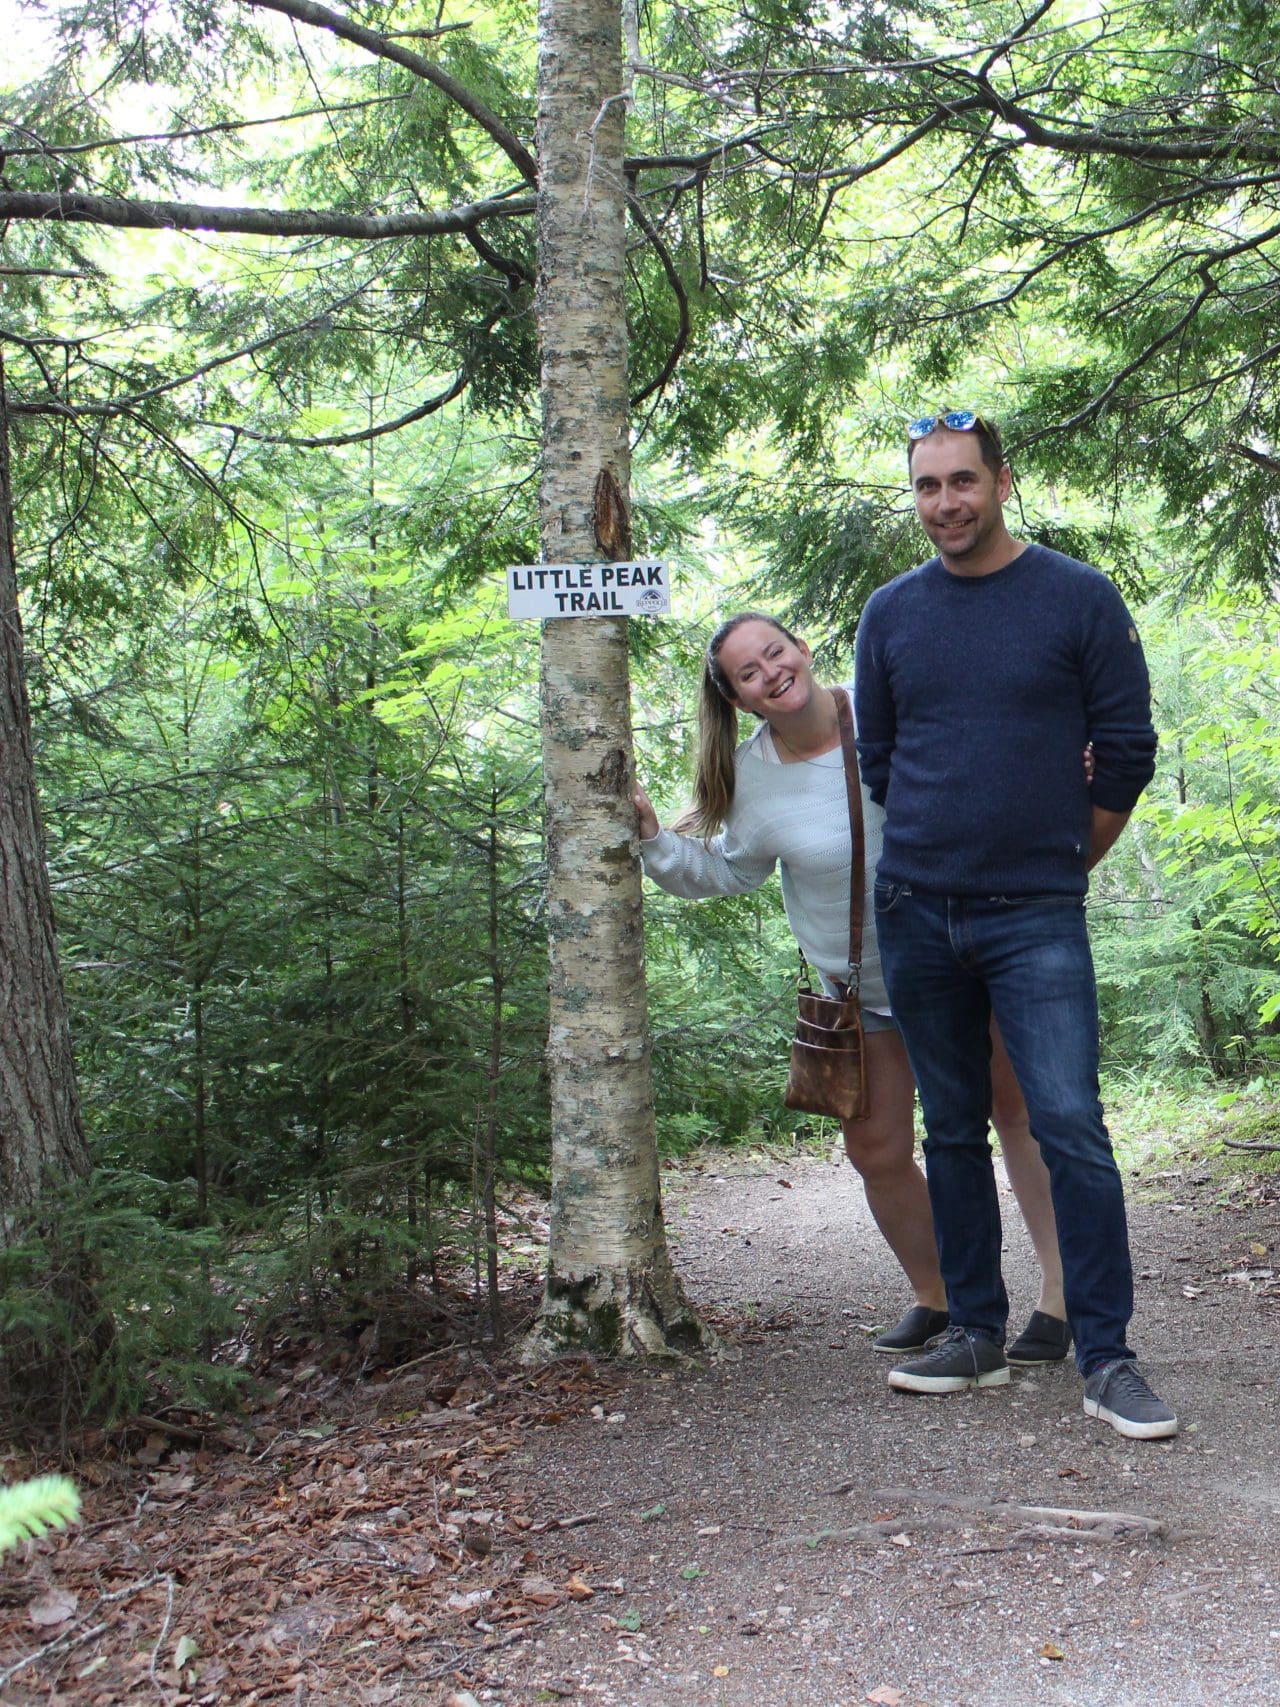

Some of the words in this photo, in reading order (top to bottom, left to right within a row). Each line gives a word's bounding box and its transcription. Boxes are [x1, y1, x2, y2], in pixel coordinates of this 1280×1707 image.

[513, 569, 592, 590] LITTLE
[601, 567, 663, 587] PEAK
[555, 592, 623, 611] TRAIL
